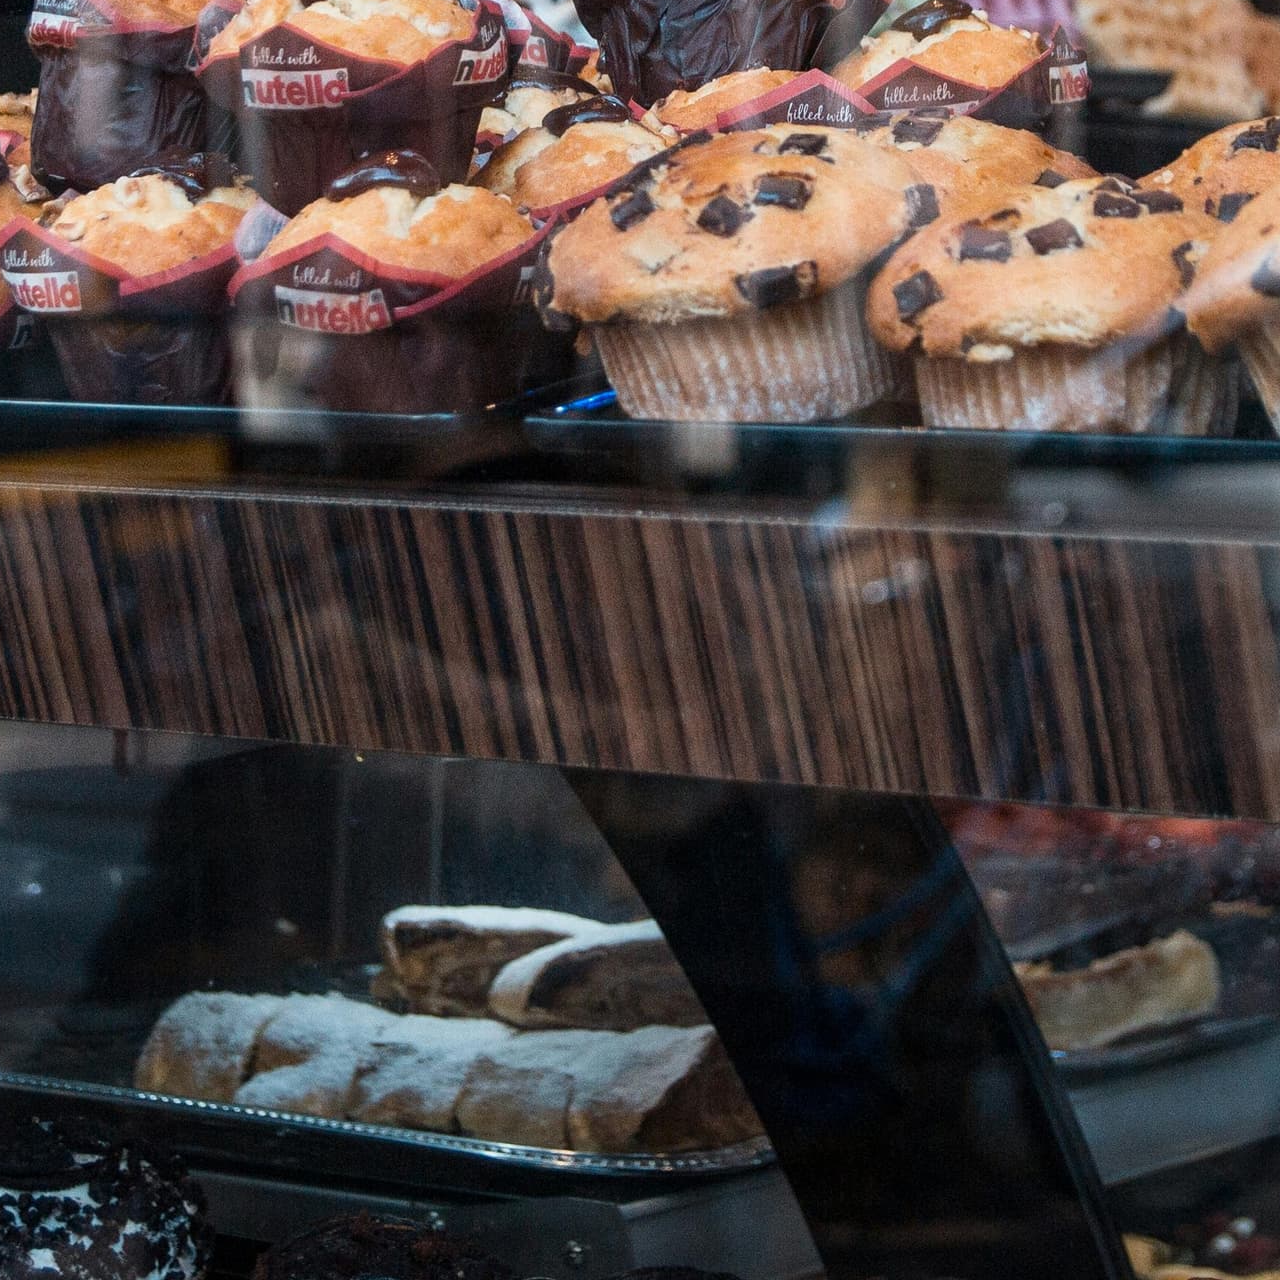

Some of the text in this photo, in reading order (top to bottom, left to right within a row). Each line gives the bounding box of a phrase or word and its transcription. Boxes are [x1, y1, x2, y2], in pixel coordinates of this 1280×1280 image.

[252, 45, 321, 67] filled with
[241, 74, 346, 106] nutella
[884, 82, 954, 108] filled with
[786, 102, 855, 124] filled with
[30, 247, 55, 267] with
[293, 265, 331, 287] filled
[277, 299, 388, 332] nutella
